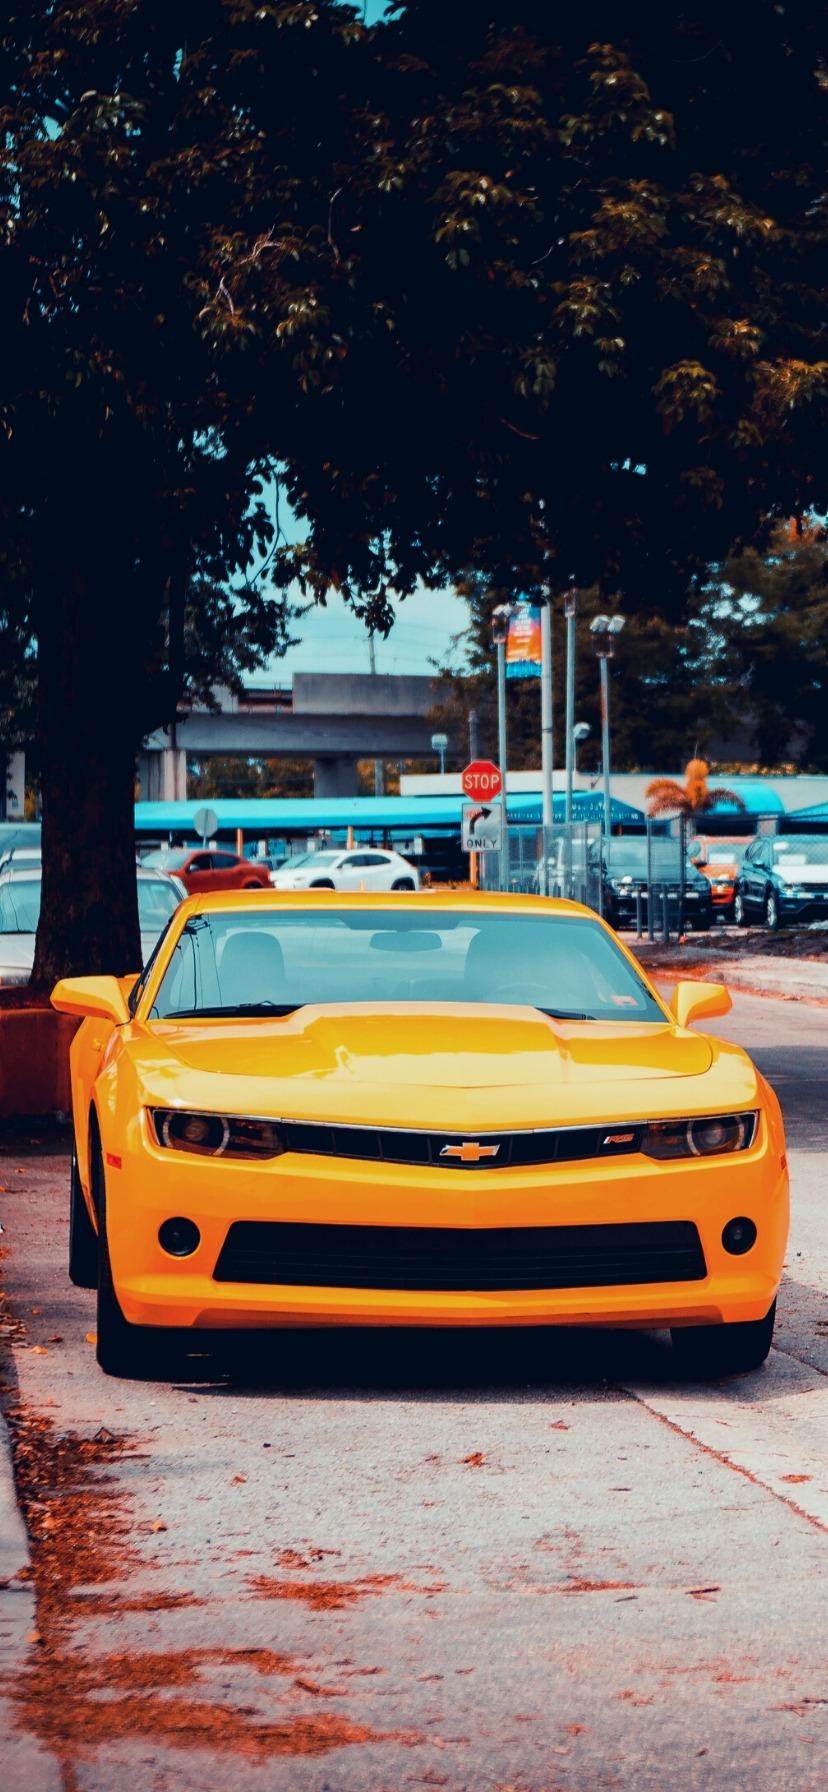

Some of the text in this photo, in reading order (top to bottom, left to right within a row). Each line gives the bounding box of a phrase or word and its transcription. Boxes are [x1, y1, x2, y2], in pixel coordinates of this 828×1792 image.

[464, 774, 500, 790] STOP
[466, 839, 497, 849] ONLY
[604, 1133, 635, 1145] RS
